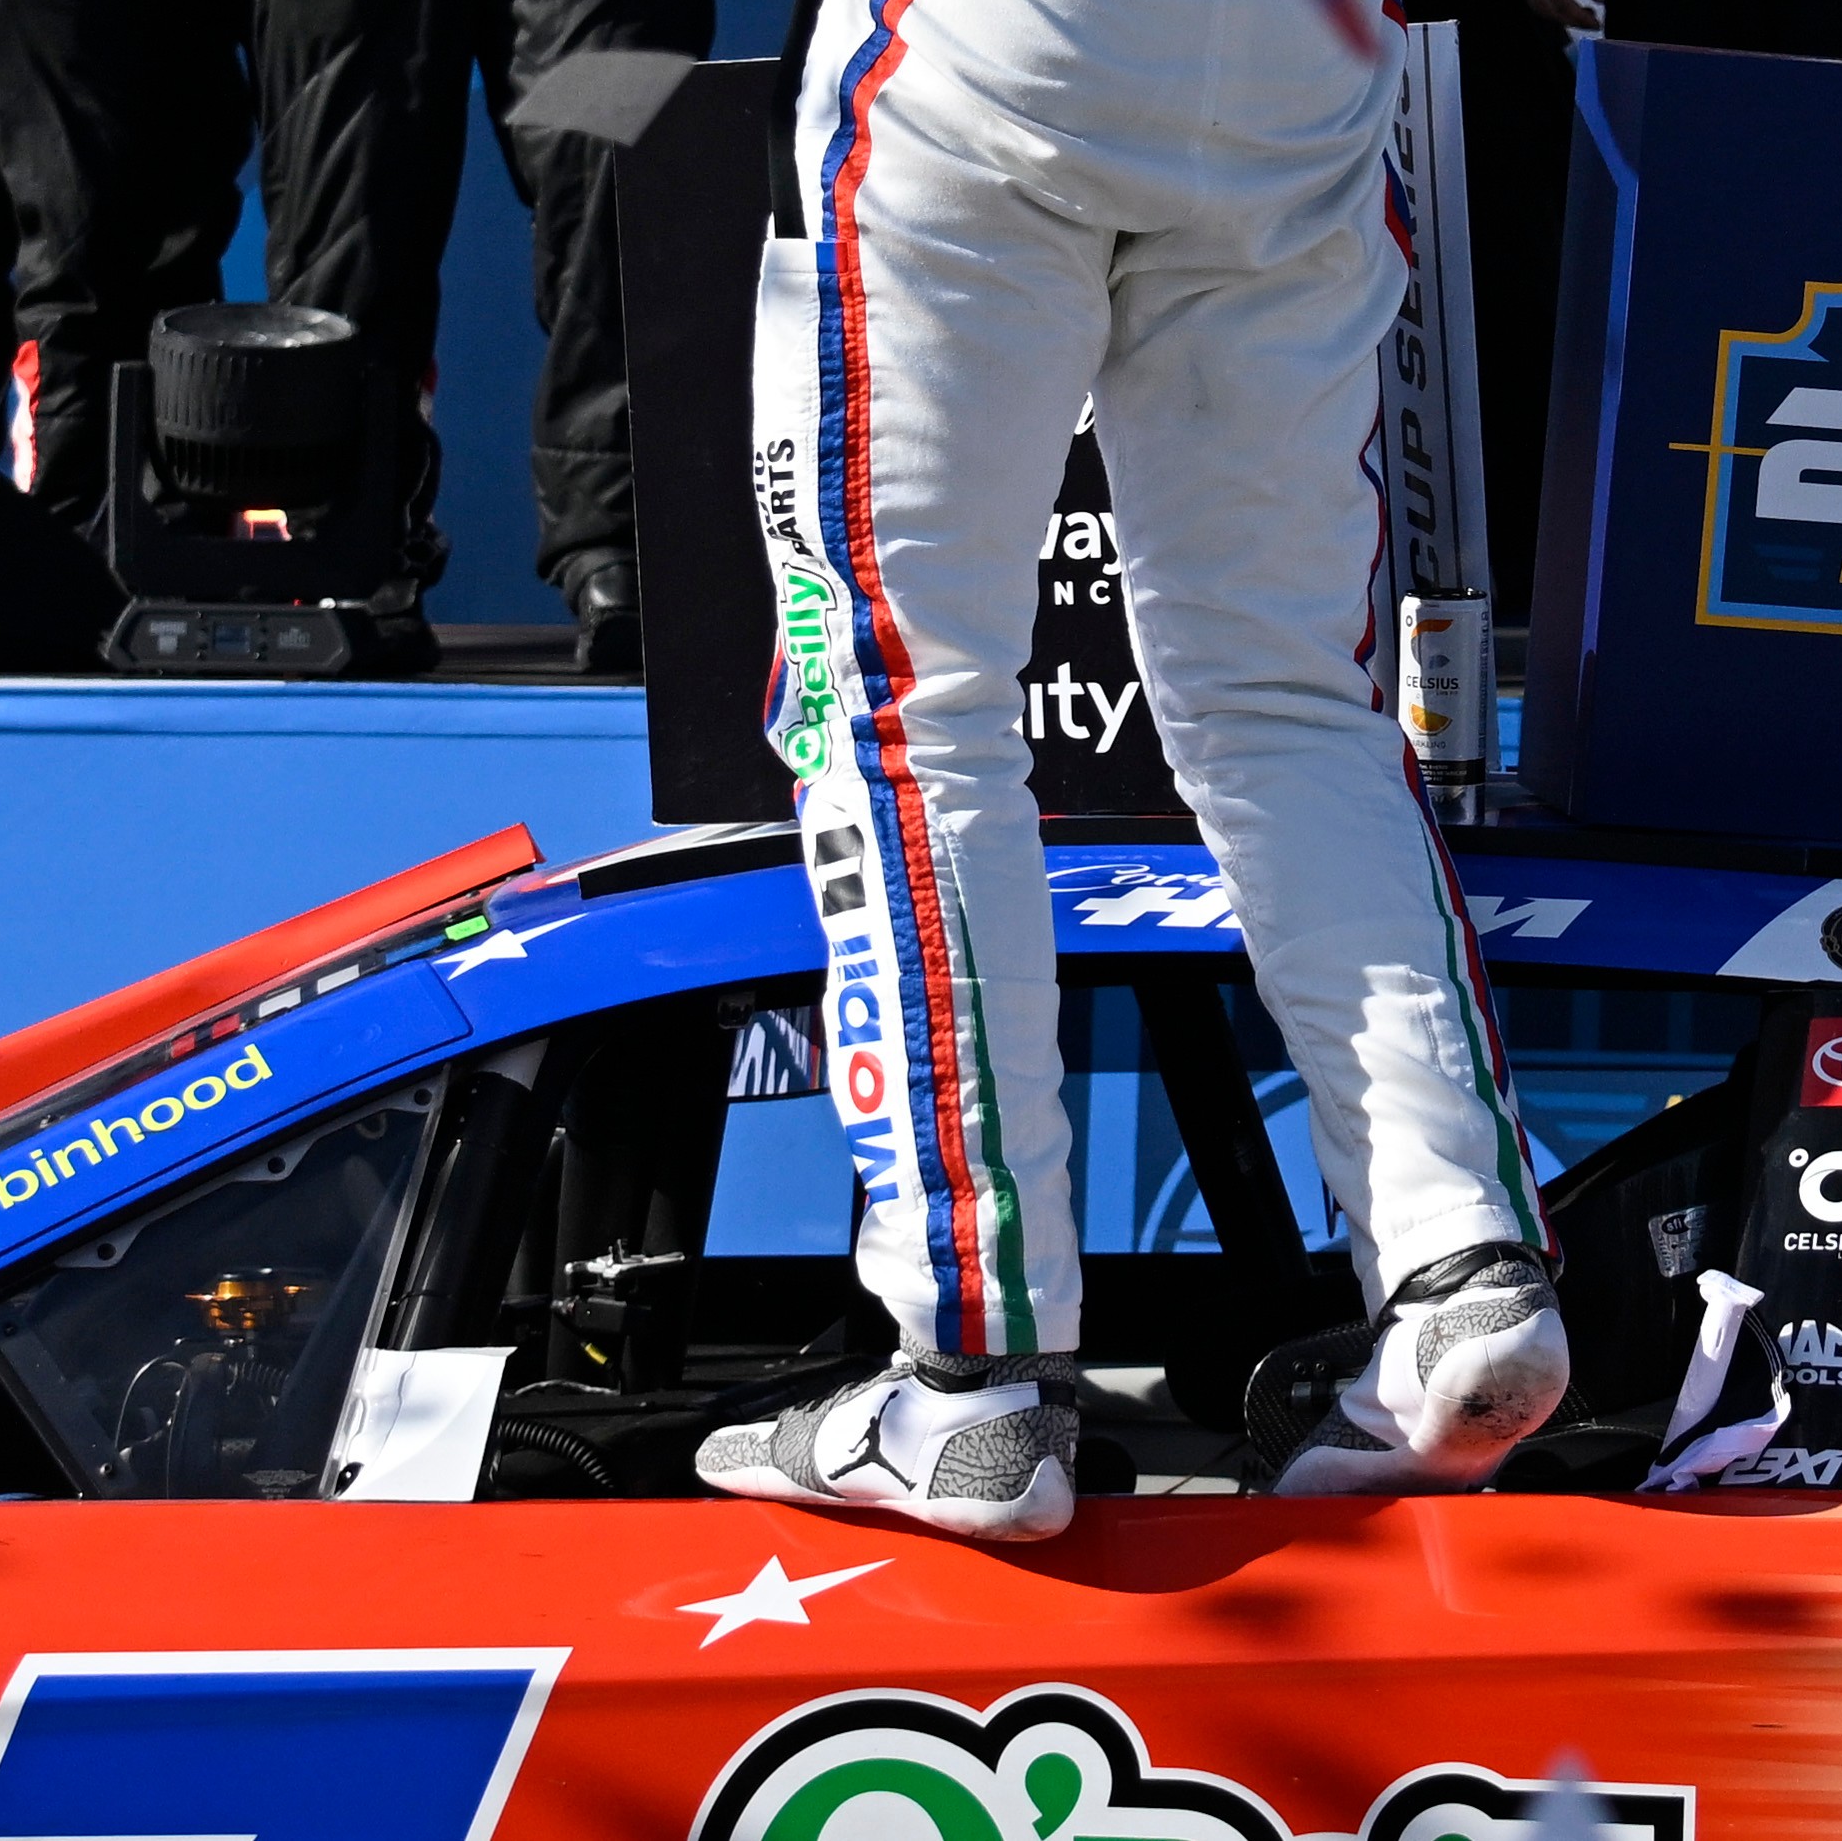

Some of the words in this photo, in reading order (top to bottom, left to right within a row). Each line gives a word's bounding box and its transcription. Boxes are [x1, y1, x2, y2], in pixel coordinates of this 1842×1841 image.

[1399, 419, 1436, 589] CUP
[1405, 674, 1459, 690] CELSIUS
[832, 932, 900, 1204] Mobil
